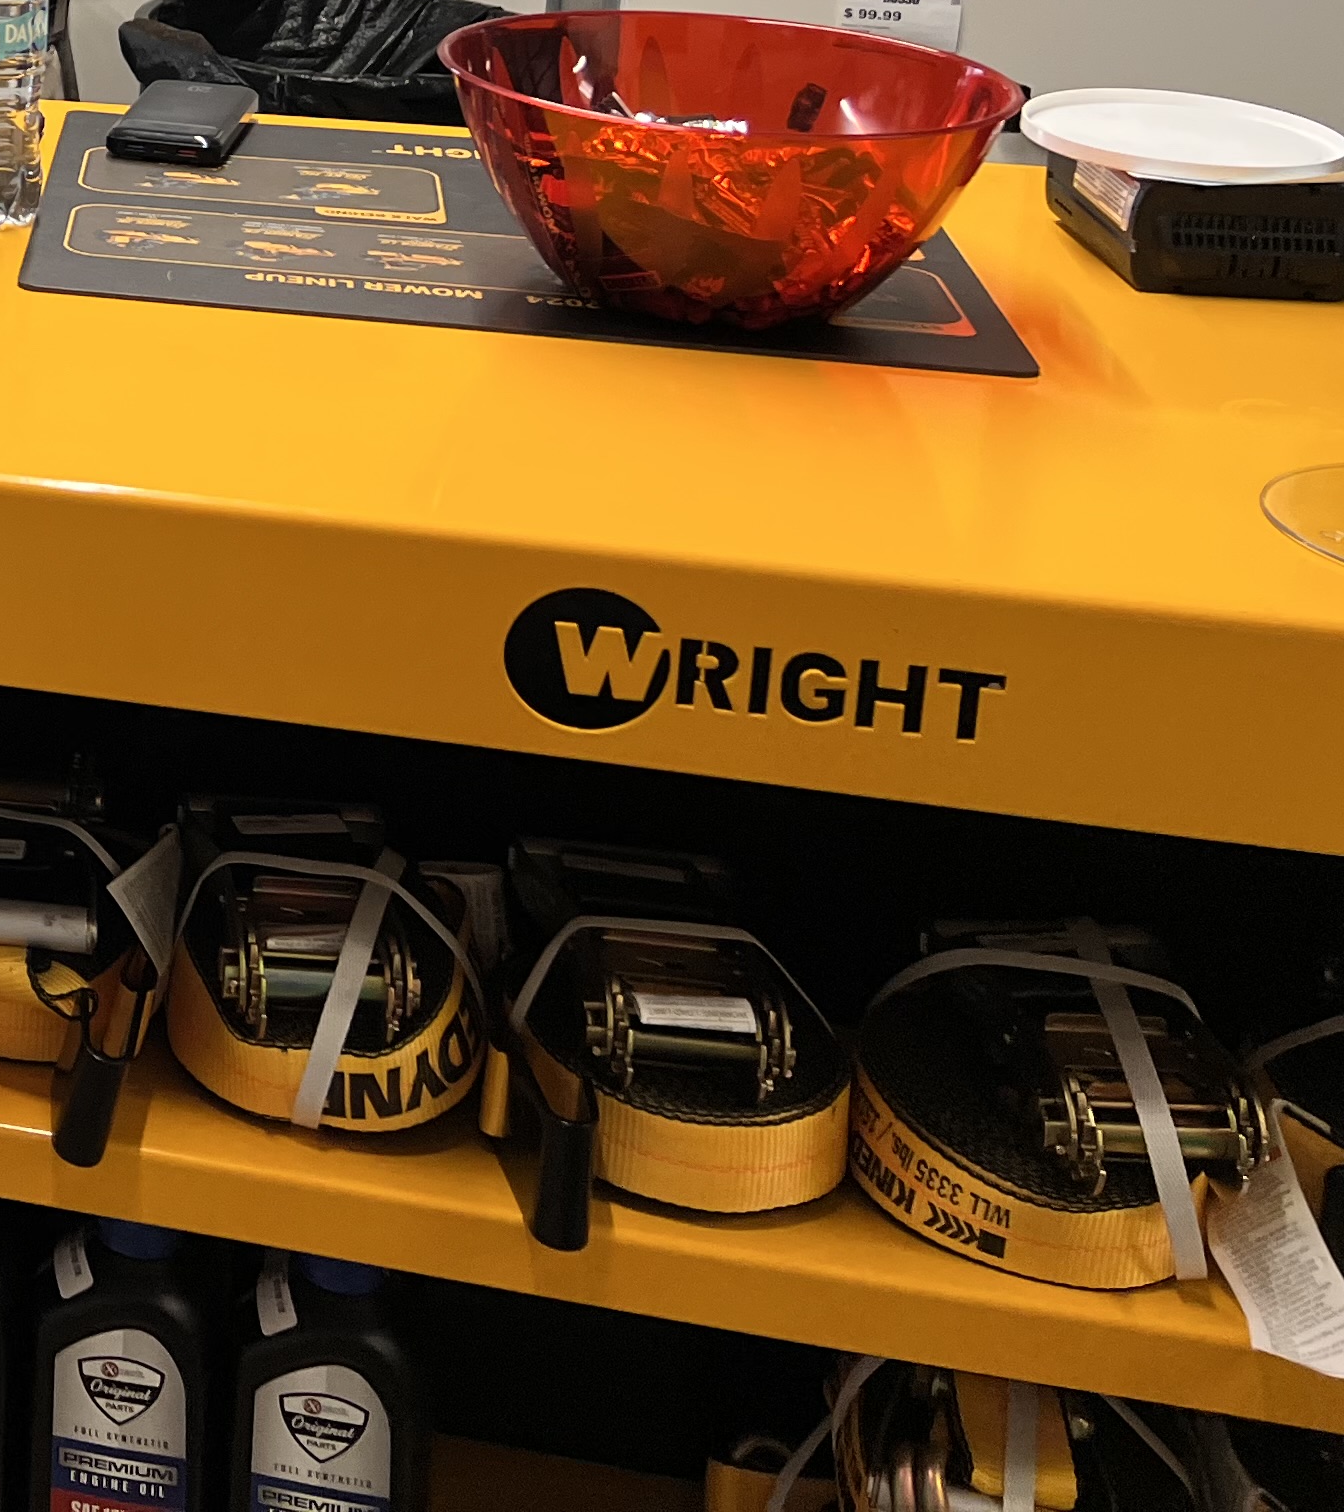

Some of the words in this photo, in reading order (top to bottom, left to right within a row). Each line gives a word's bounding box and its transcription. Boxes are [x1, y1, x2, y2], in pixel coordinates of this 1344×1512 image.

[844, 7, 853, 19] $
[858, 8, 902, 21] 99.99
[243, 271, 356, 290] LINEUP
[552, 619, 1008, 743] WRIGHT
[63, 1450, 174, 1482] PREMIUM
